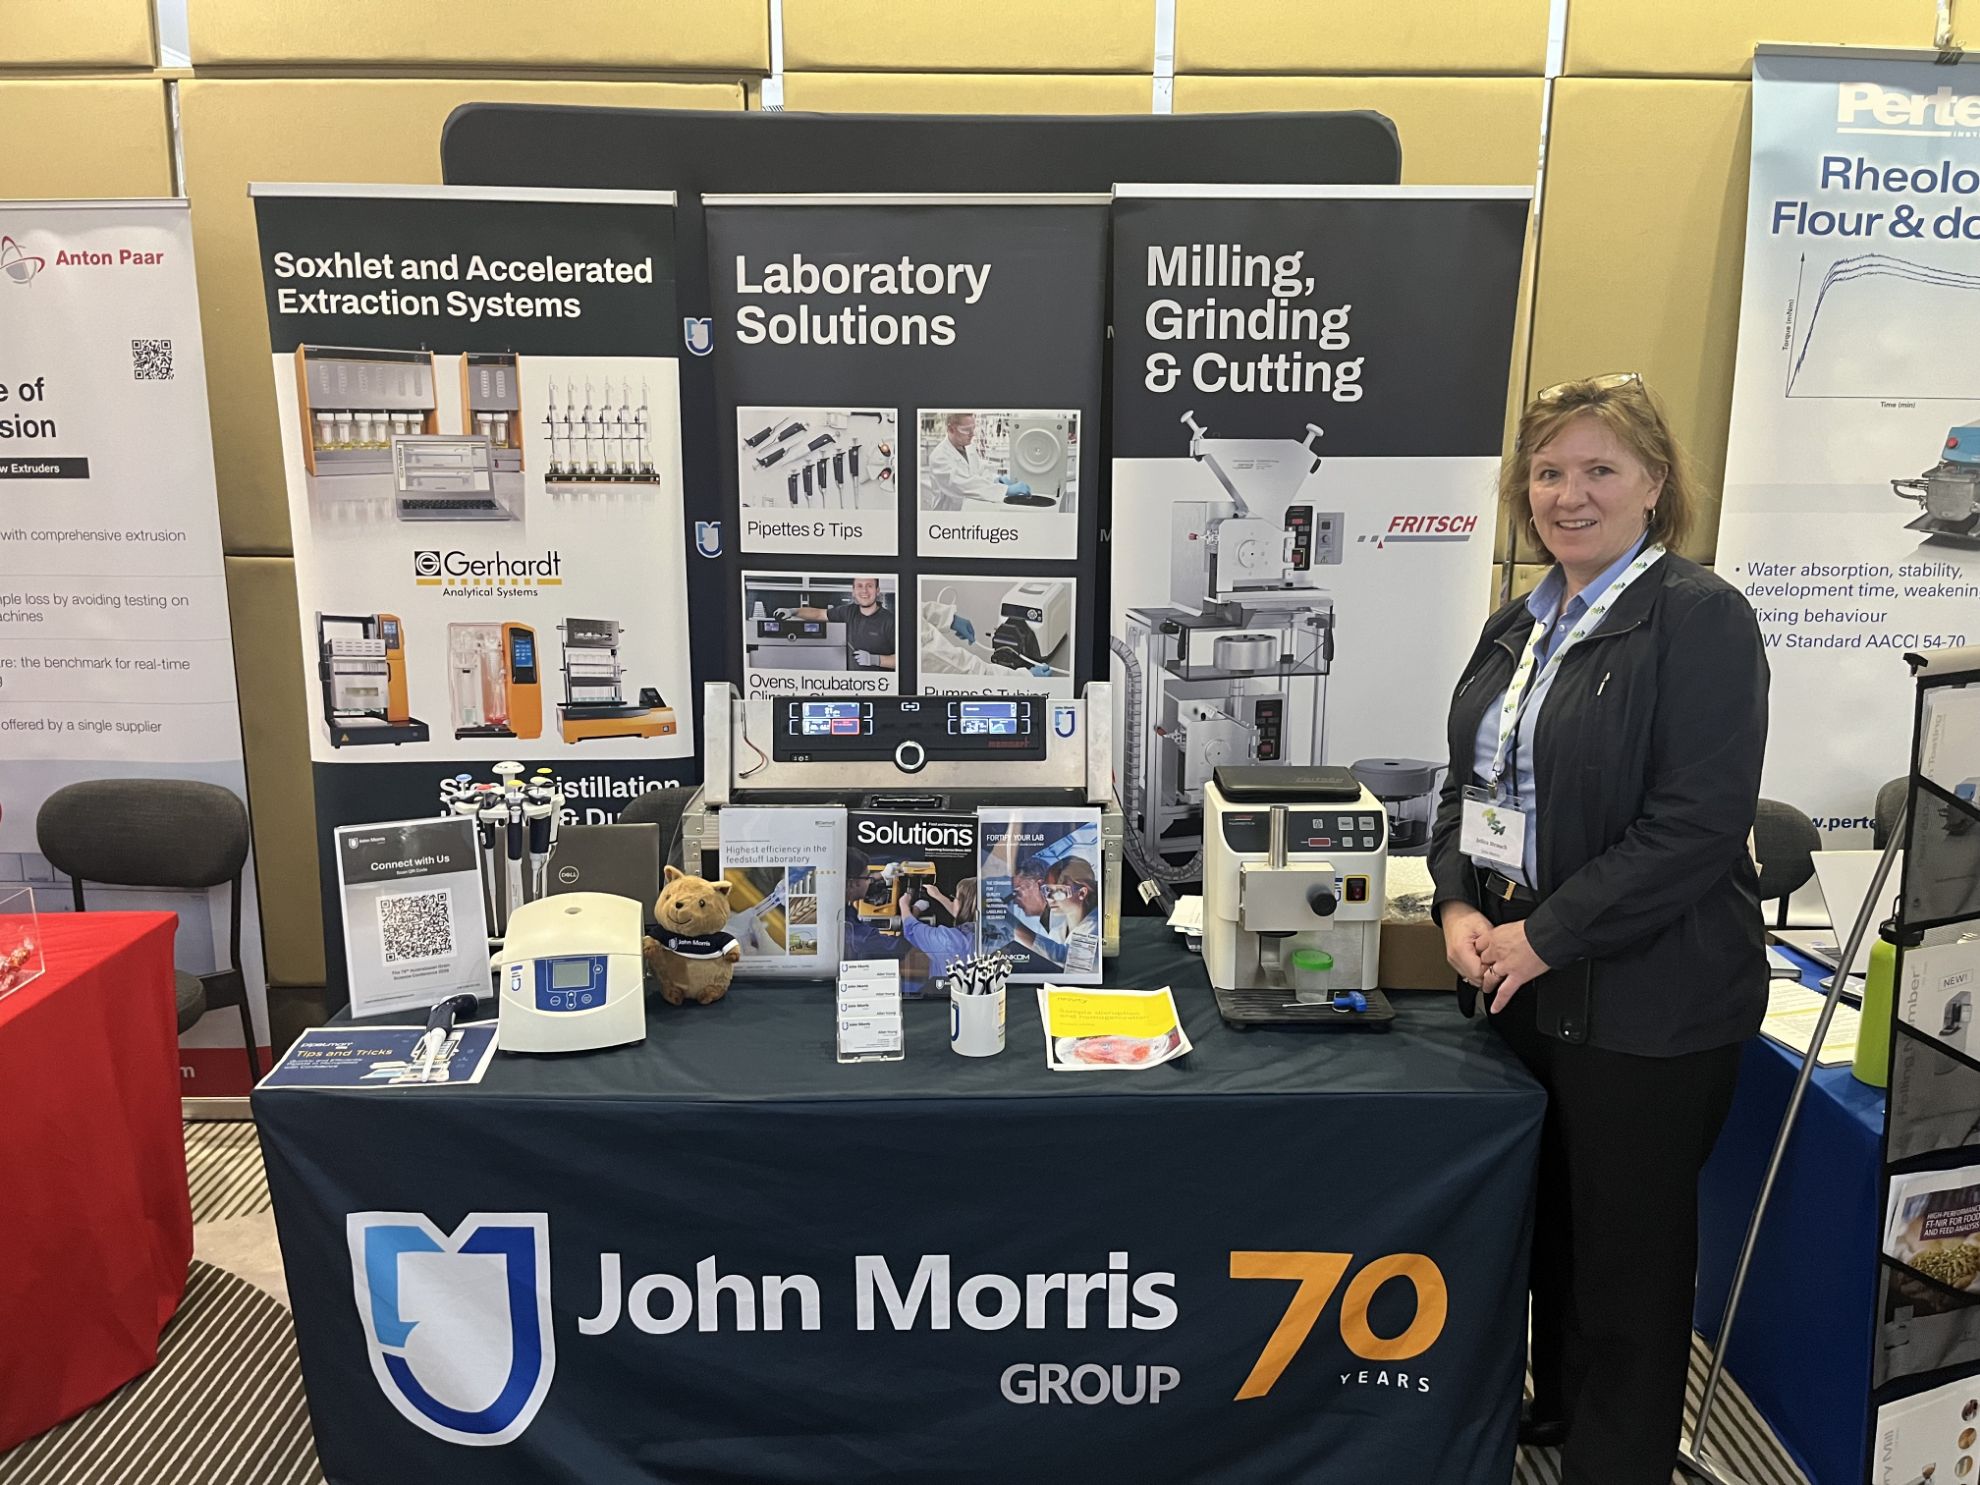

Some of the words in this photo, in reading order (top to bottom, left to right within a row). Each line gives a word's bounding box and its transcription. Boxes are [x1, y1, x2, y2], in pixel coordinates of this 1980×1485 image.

[1820, 156, 1980, 195] Rheolo
[1772, 201, 1883, 236] Flour
[1888, 204, 1924, 239] &
[56, 249, 112, 266] Anton
[119, 248, 164, 266] Paar
[273, 251, 395, 280] Soxhlet
[400, 253, 459, 281] and
[465, 255, 653, 284] Accelerated
[1147, 243, 1315, 298] Milling,
[736, 253, 992, 304] Laboratory
[277, 288, 439, 316] Extraction
[445, 290, 582, 322] Systems
[735, 305, 957, 346] Solutions
[1144, 297, 1352, 351] Grinding
[1144, 353, 1181, 393] &
[1192, 351, 1365, 403] Cutting
[19, 377, 45, 402] of
[11, 462, 61, 475] Extruders
[748, 520, 810, 539] Pipettes
[813, 522, 825, 538] &
[829, 521, 863, 541] Tips
[1388, 515, 1478, 533] FRITSCH
[1, 529, 27, 541] with
[31, 529, 122, 543] comprehensive
[126, 529, 187, 542] extrusion
[928, 524, 1019, 544] Centrifuges
[444, 550, 562, 577] Gerhardt
[1747, 561, 1796, 577] Water
[1800, 562, 1894, 580] absorption,
[1898, 562, 1963, 580] stability,
[442, 586, 494, 598] Analytical
[496, 587, 538, 599] Systems
[1745, 582, 1853, 600] development
[1858, 583, 1899, 599] time,
[1904, 583, 1980, 600] weakenin
[25, 593, 50, 606] loss
[53, 594, 68, 608] by
[72, 594, 121, 608] avoiding
[124, 594, 167, 609] testing
[171, 597, 189, 607] on
[1754, 608, 1799, 625] ixing
[1804, 608, 1888, 623] behaviour
[1786, 633, 1861, 648] Standard
[1866, 634, 1918, 649] AACCI
[1923, 635, 1966, 649] 54-70
[21, 657, 41, 668] the
[44, 657, 113, 669] benchmark
[115, 657, 130, 670] for
[134, 658, 191, 670] real-time
[749, 673, 799, 691] Ovens,
[801, 676, 876, 691] Incubators
[878, 677, 890, 692] &
[1, 718, 44, 731] offered
[48, 719, 63, 733] by
[67, 722, 75, 731] a
[78, 719, 113, 733] single
[116, 720, 162, 733] supplier
[857, 821, 974, 847] Solutions
[1013, 834, 1031, 842] YOUR
[726, 846, 759, 855] Highest
[761, 846, 802, 855] efficiency
[813, 844, 828, 853] the
[370, 858, 414, 871] Connect
[415, 855, 436, 866] with
[436, 854, 451, 864] Us
[726, 855, 765, 864] feedstuff
[766, 855, 810, 864] laboratory
[1943, 974, 1969, 988] NEW!
[297, 1050, 323, 1059] Tips
[356, 1048, 393, 1057] Tricks
[1948, 1216, 1963, 1226] FOR
[1923, 1229, 1938, 1237] AND
[1939, 1226, 1955, 1235] FEED
[578, 1252, 821, 1334] John
[856, 1250, 1179, 1332] Morris
[1229, 1250, 1449, 1402] 70
[999, 1363, 1181, 1405] GROUP
[1339, 1370, 1431, 1394] YEARS
